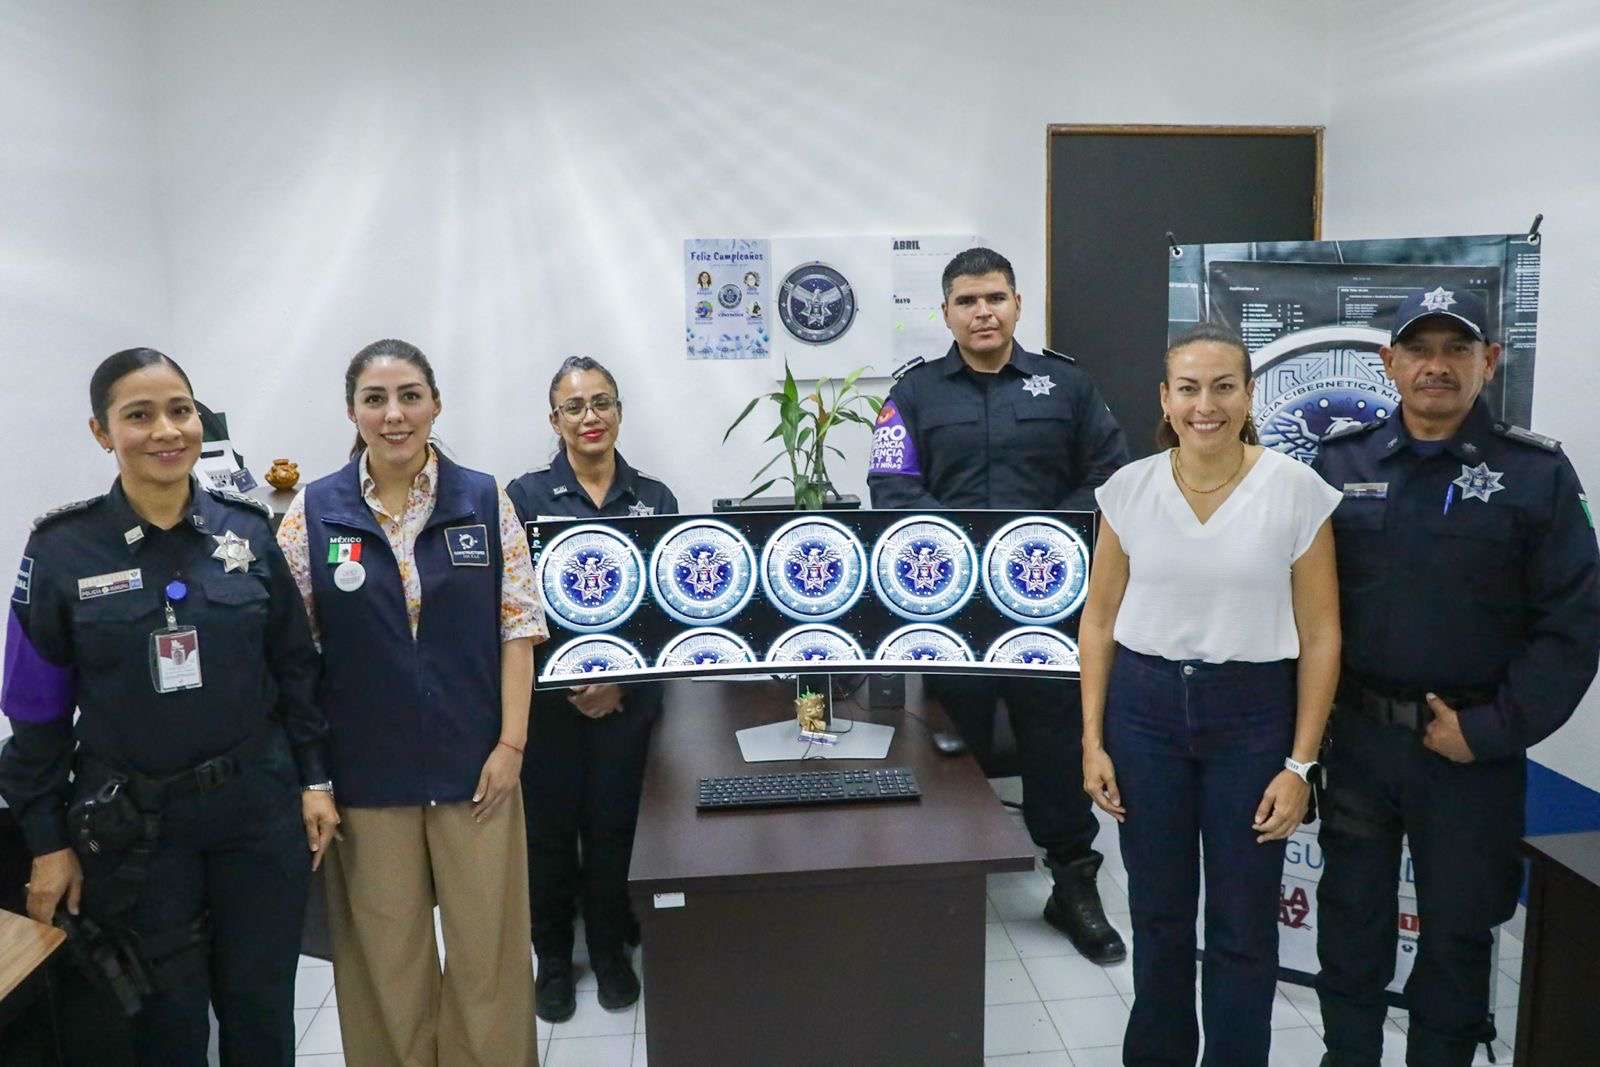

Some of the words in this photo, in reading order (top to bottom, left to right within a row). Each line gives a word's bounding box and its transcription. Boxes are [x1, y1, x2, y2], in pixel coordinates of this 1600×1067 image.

[893, 240, 920, 250] ABRIL
[691, 251, 711, 261] Feliz
[713, 251, 763, 263] Cumpleaños
[1284, 380, 1377, 401] CIBERNETICA
